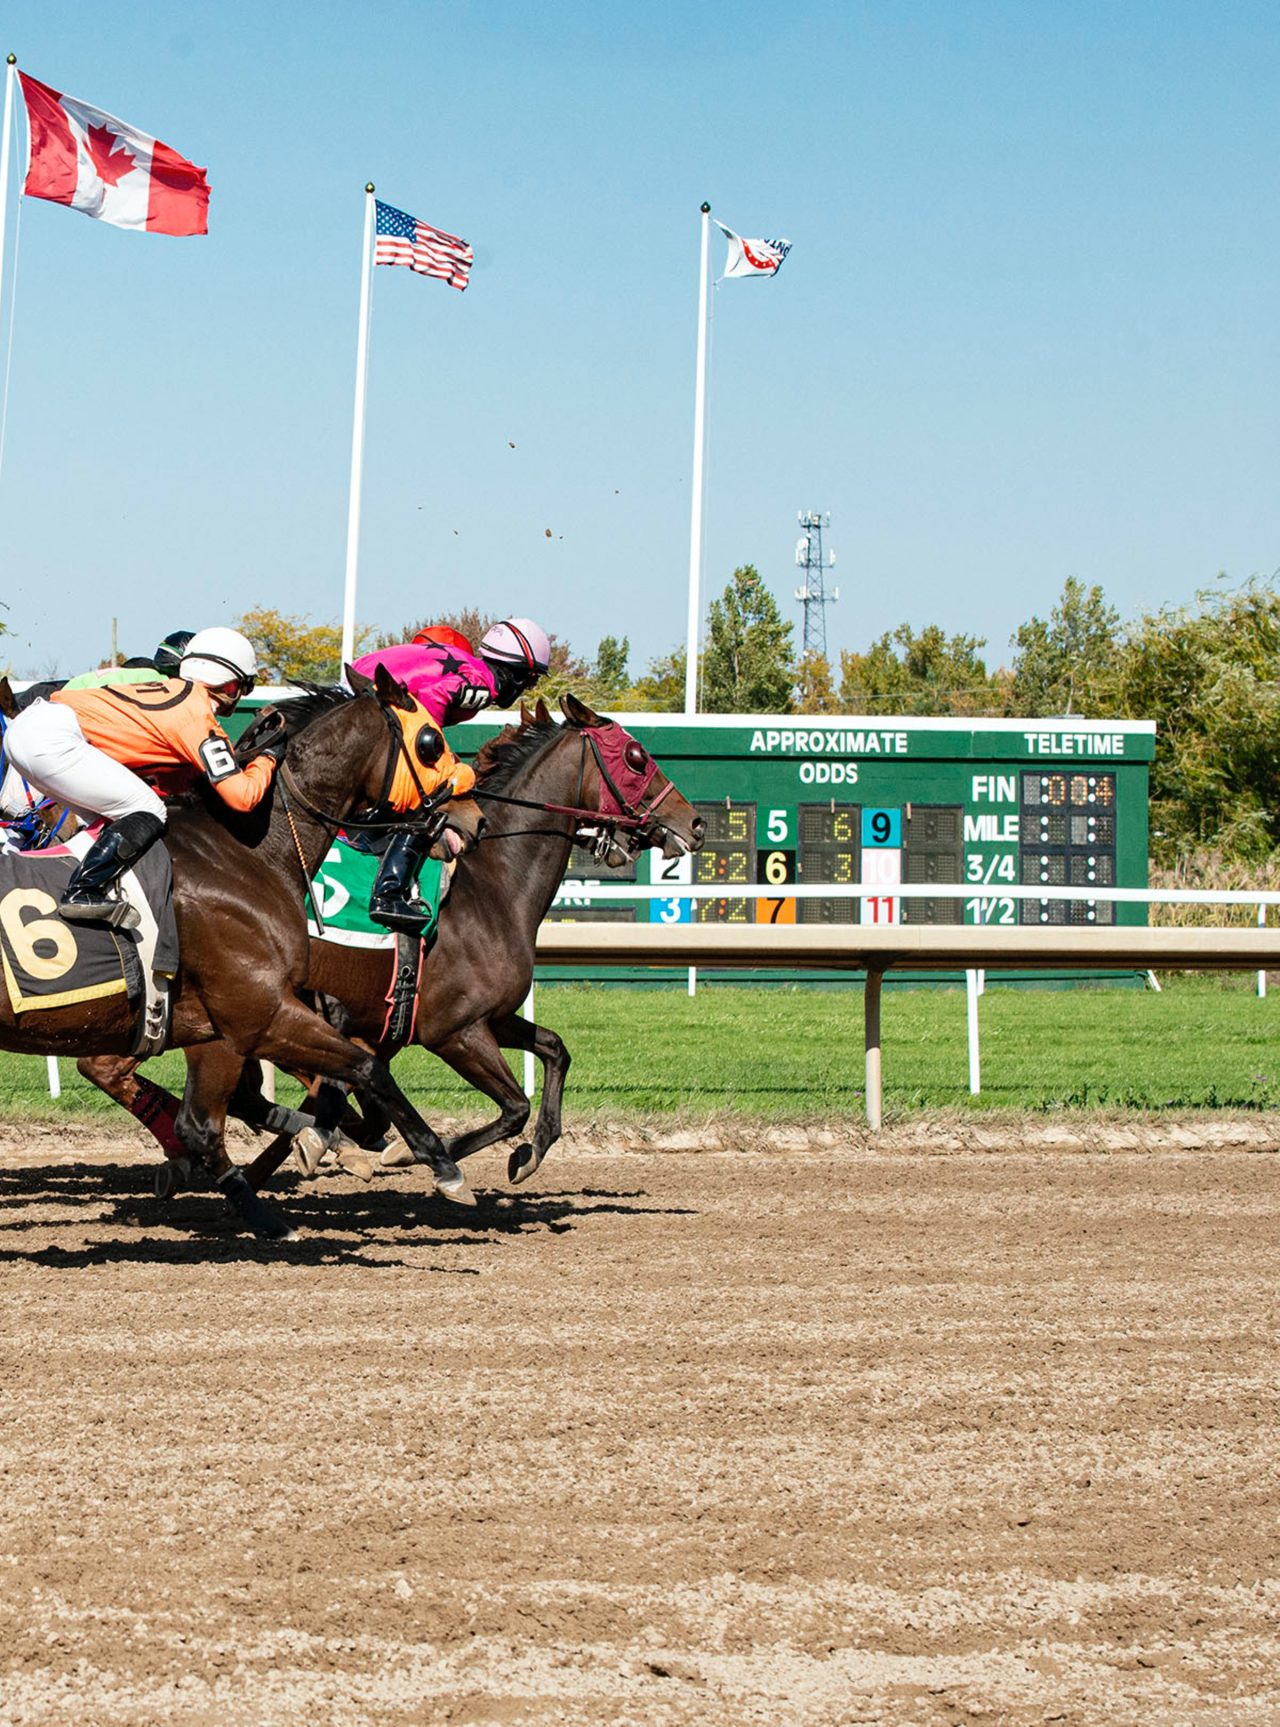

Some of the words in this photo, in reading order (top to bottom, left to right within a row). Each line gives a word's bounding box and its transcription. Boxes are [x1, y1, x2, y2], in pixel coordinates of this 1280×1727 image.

[750, 731, 907, 752] APPROXIMATE
[1023, 734, 1124, 754] TELETIME
[205, 745, 235, 775] 6
[799, 763, 858, 783] ODDS
[972, 776, 1016, 802] FIN
[729, 812, 747, 839] 5
[767, 810, 788, 842] 5
[834, 813, 851, 840] 6
[872, 813, 890, 843] 9
[964, 815, 1019, 841] MILE
[765, 852, 787, 884] 6
[834, 854, 851, 881] 3
[967, 855, 1015, 884] 3/4
[660, 898, 681, 923] 3
[766, 898, 786, 923] 7
[867, 897, 893, 923] 11
[967, 897, 1015, 924] 1/2
[0, 888, 77, 979] 6
